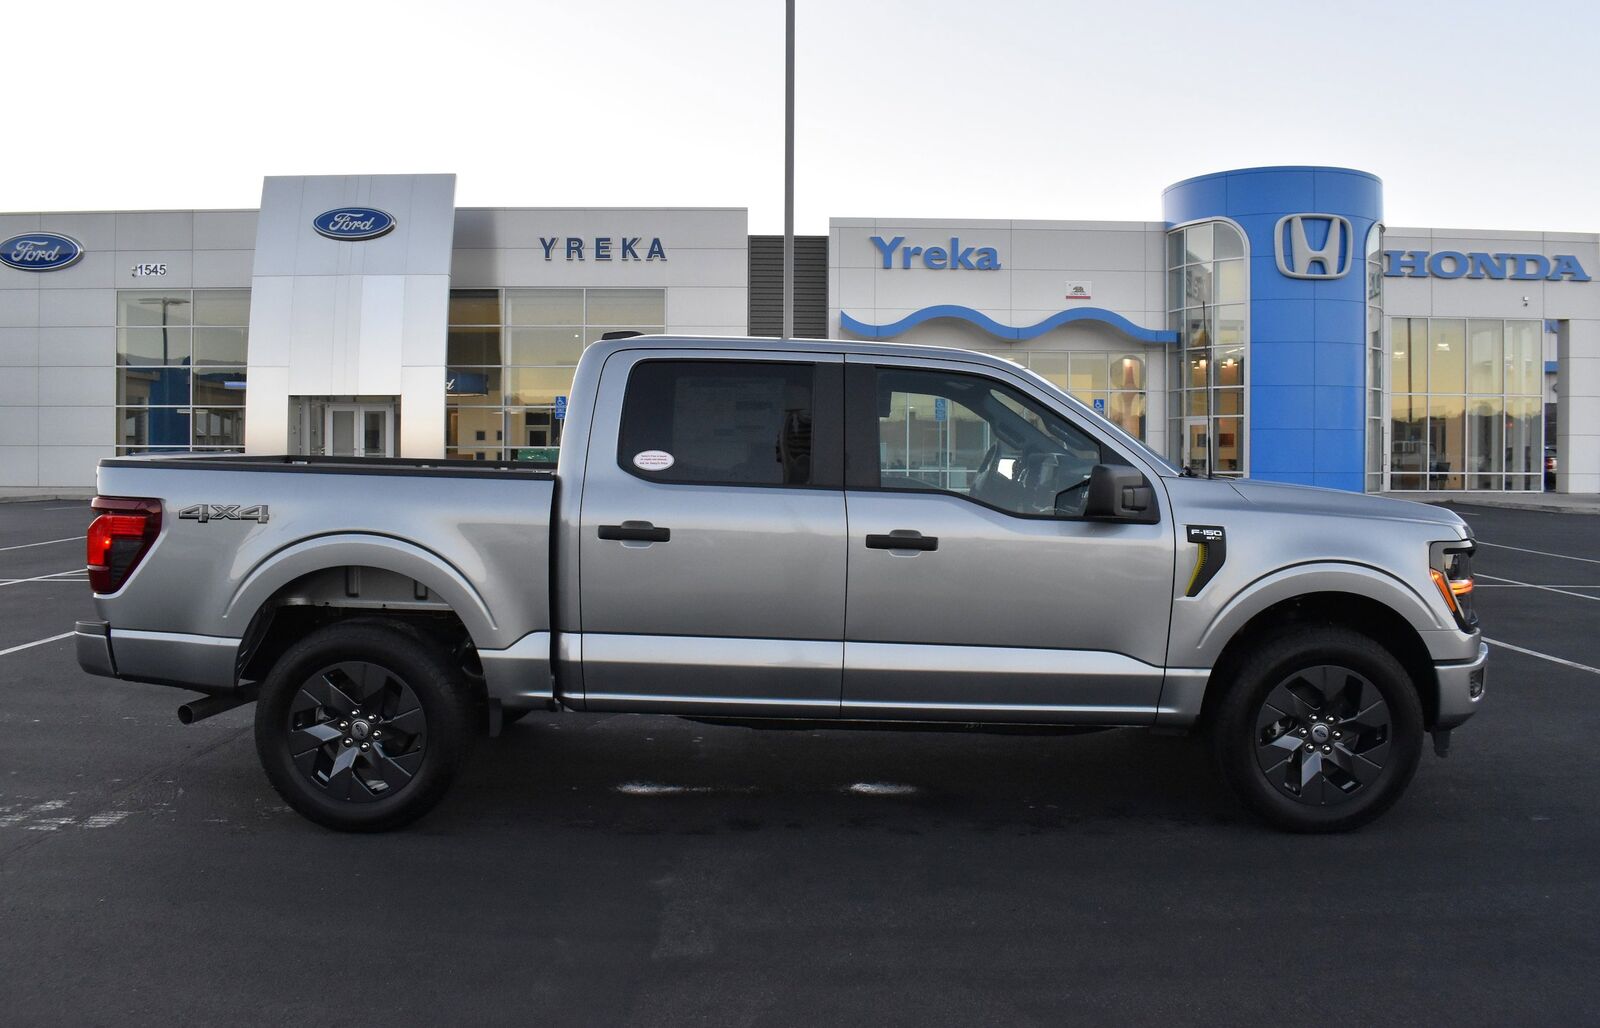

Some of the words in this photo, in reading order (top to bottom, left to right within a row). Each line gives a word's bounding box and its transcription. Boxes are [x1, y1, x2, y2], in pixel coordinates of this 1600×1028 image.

[329, 213, 375, 231] Ford
[11, 240, 60, 262] Ford
[539, 237, 668, 261] YREKA
[869, 236, 1001, 270] Yreka
[138, 264, 167, 276] 1545
[1384, 250, 1592, 282] HONDA
